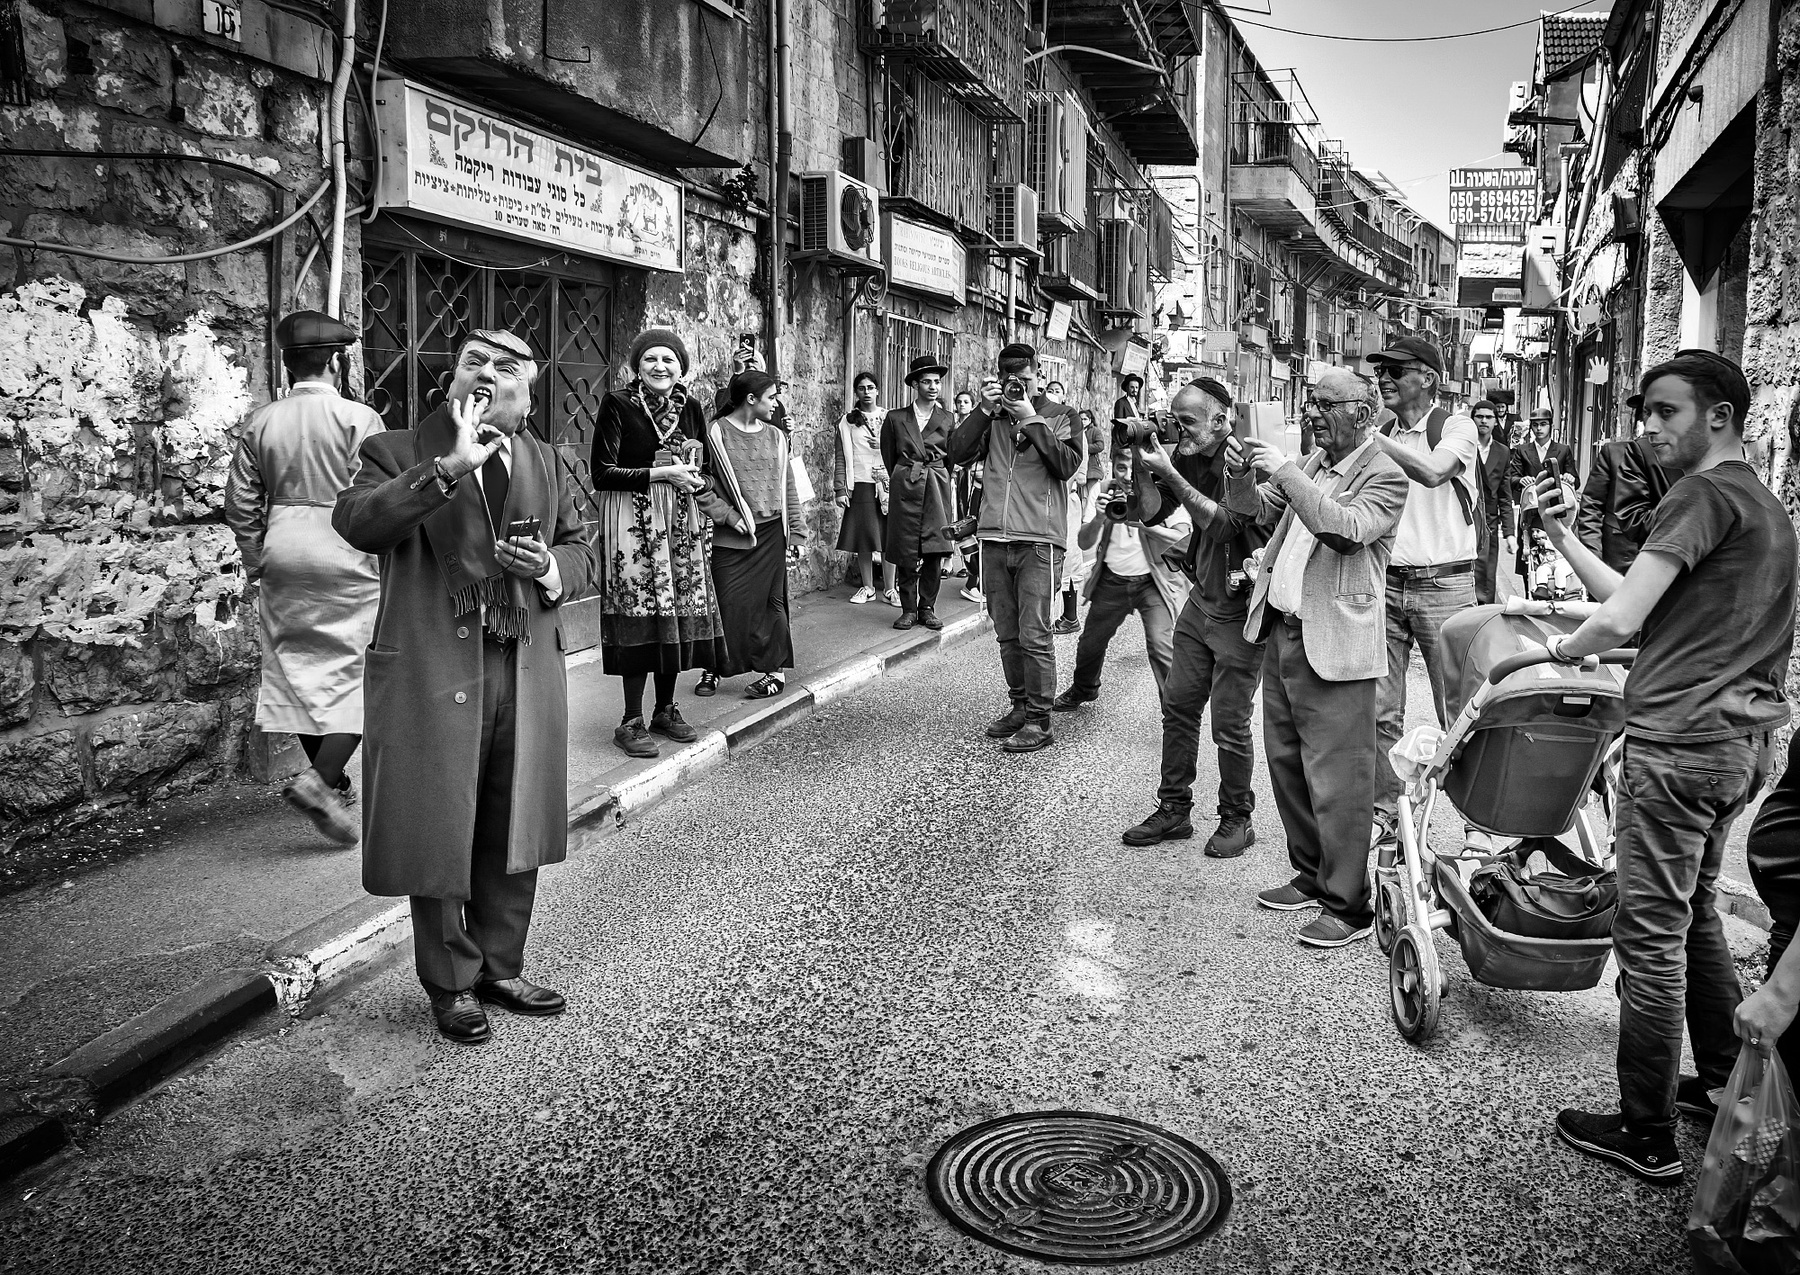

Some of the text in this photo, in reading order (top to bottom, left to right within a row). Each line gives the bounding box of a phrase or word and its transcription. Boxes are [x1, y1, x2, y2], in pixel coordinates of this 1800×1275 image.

[425, 98, 603, 187] בית הרוקם
[414, 170, 449, 193] ציציות
[455, 152, 586, 208] כל סוגי עבודות ריקמה
[498, 194, 523, 213] כיפות
[1450, 189, 1535, 207] 050-8694625
[494, 210, 503, 222] 10
[506, 213, 529, 228] שערים
[555, 208, 583, 229] מעילים
[1450, 206, 1535, 223] 050-5704272
[532, 219, 546, 232] מאה
